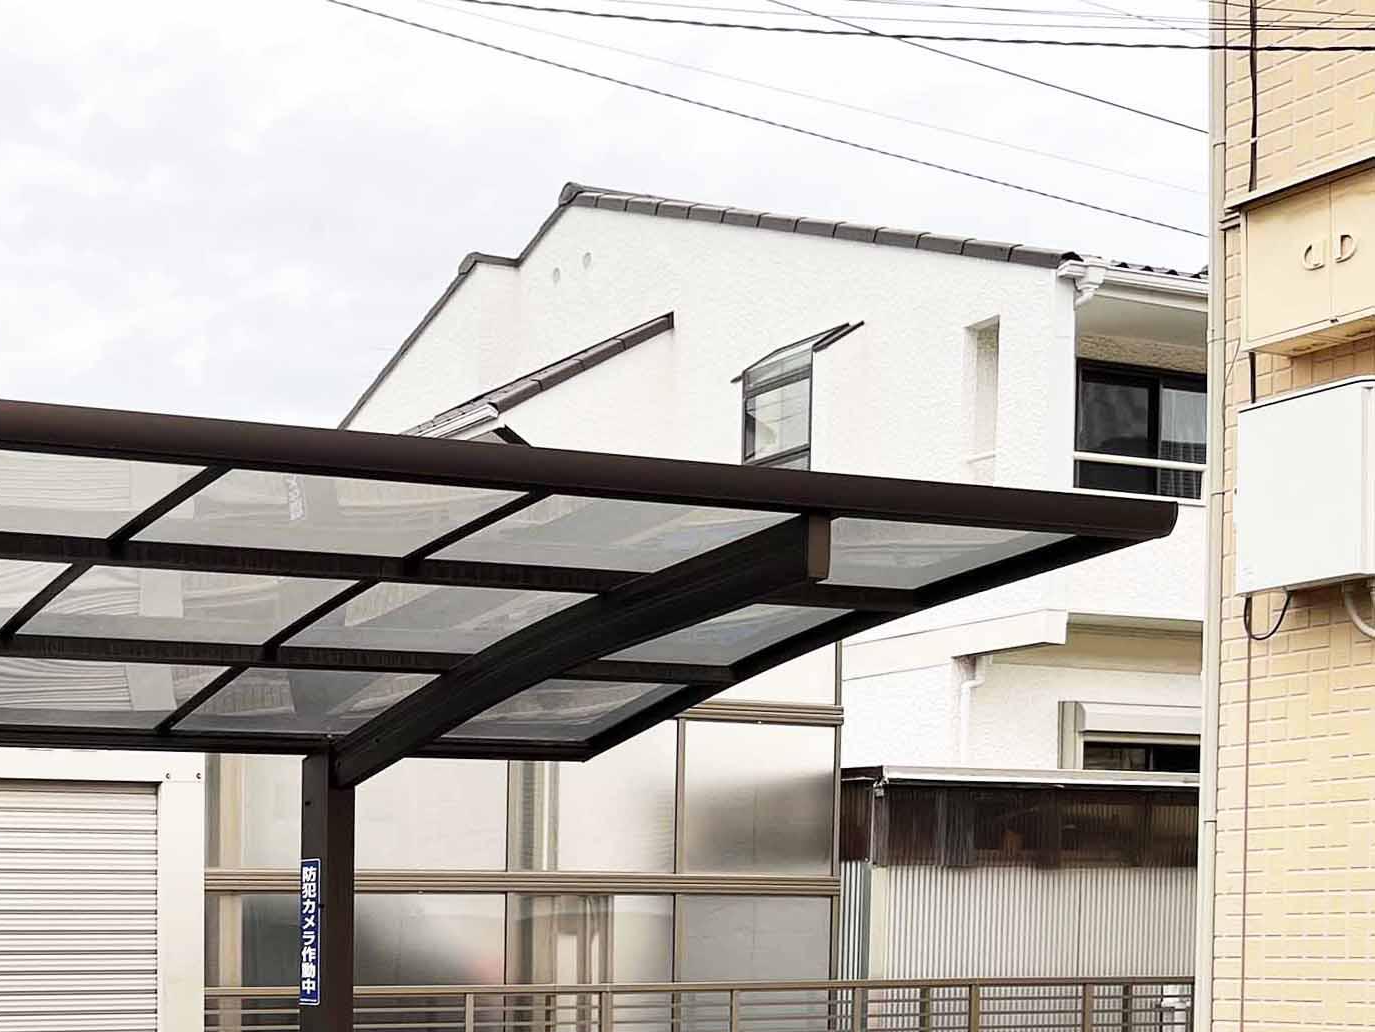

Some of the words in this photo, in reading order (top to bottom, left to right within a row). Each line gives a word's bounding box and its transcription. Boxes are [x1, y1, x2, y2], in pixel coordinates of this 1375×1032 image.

[301, 866, 317, 994] 防犯カメラ作動中
